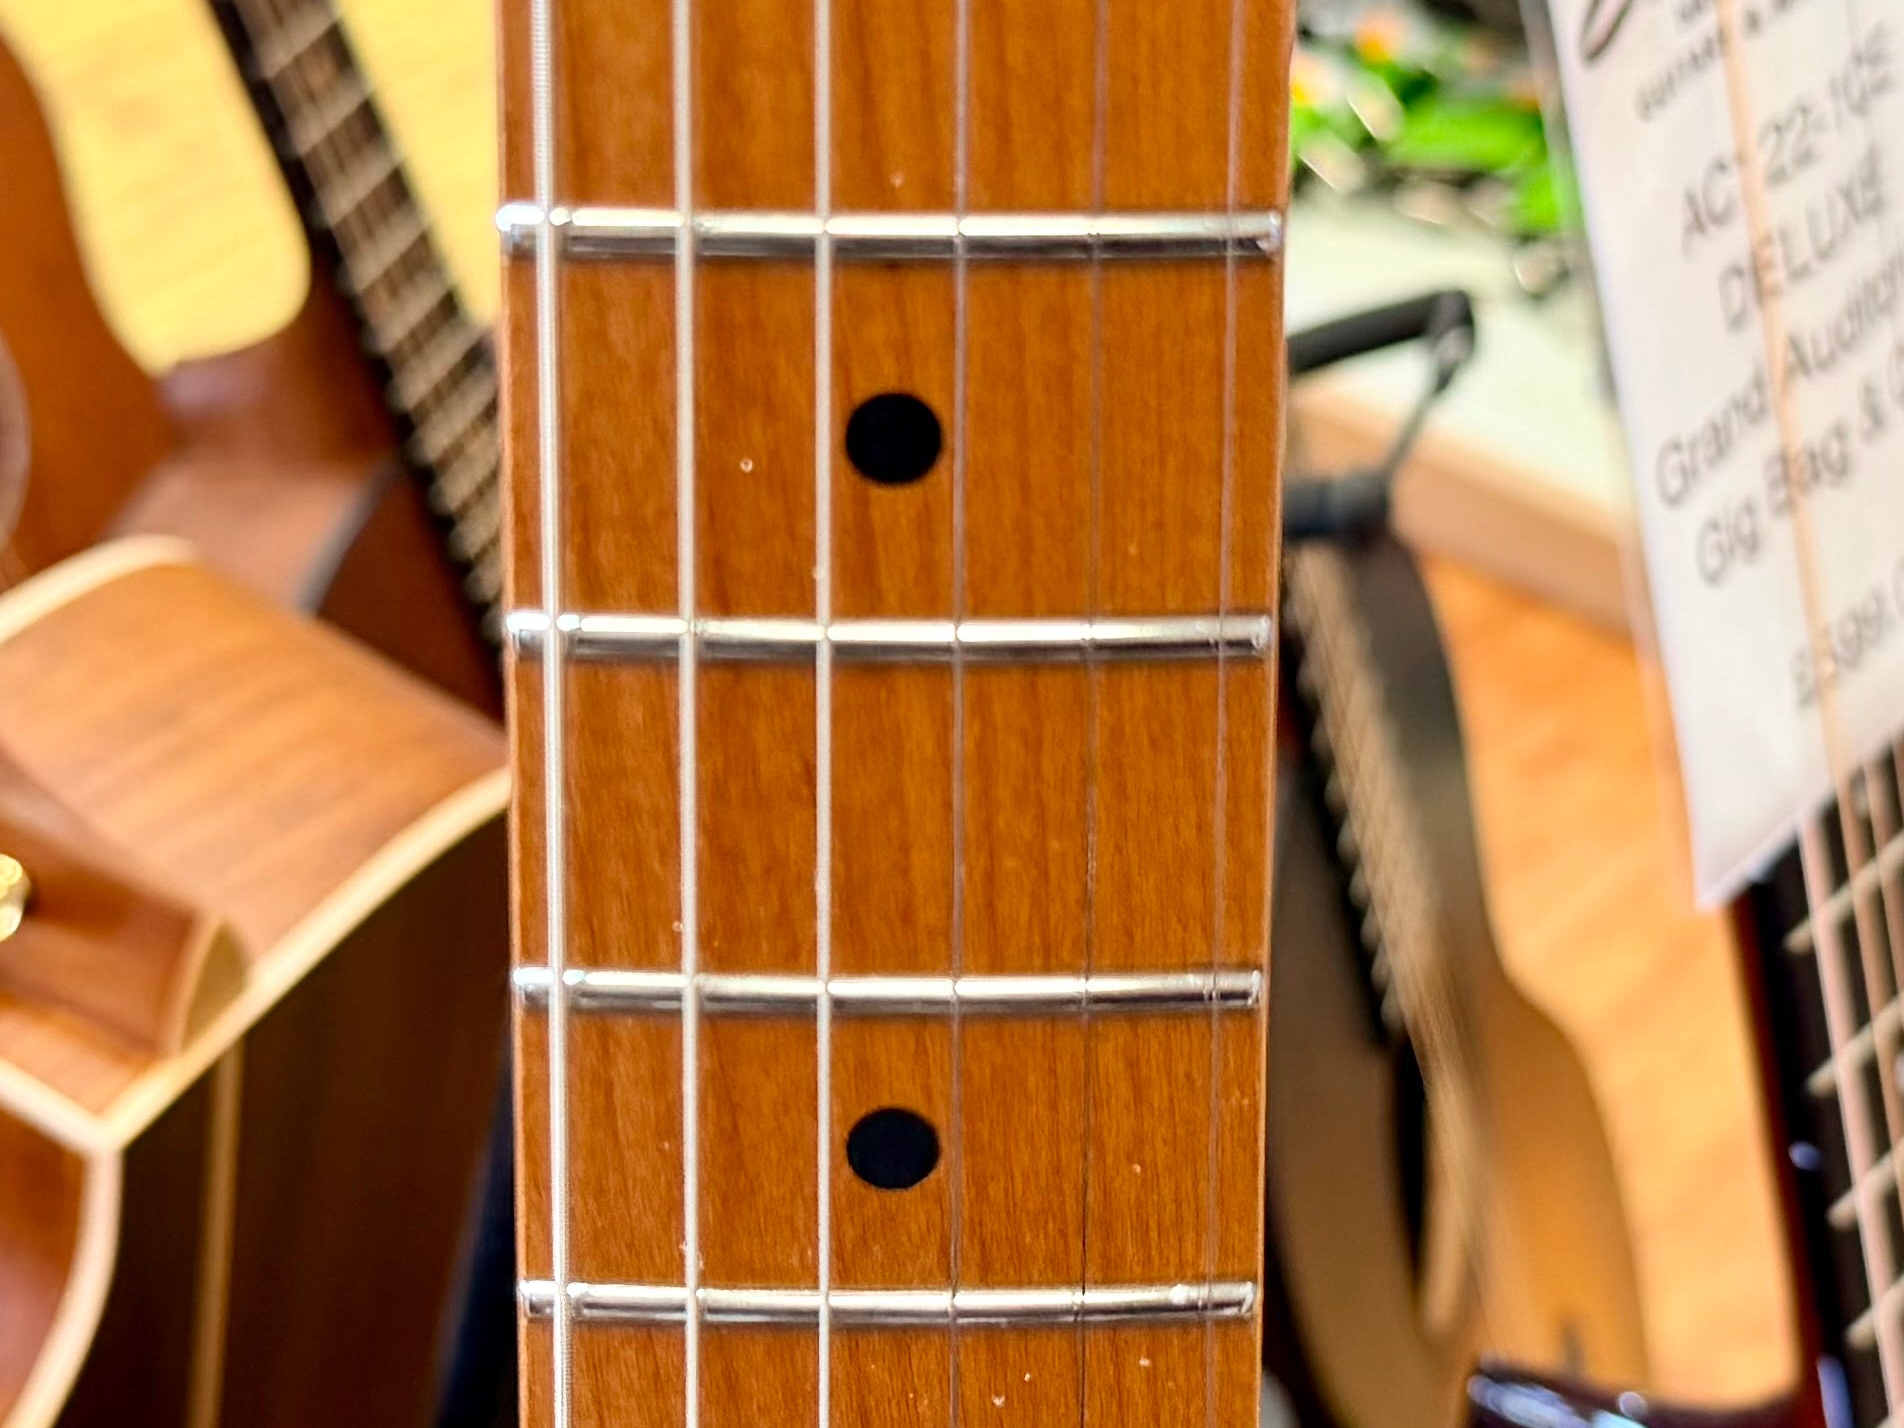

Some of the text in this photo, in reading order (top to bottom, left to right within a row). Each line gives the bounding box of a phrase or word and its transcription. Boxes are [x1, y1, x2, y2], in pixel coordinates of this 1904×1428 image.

[1718, 137, 1887, 331] DELUXE
[1655, 357, 1769, 512] Grand
[1696, 496, 1761, 588] Gig
[1763, 417, 1853, 517] Bag
[1857, 379, 1888, 445] &
